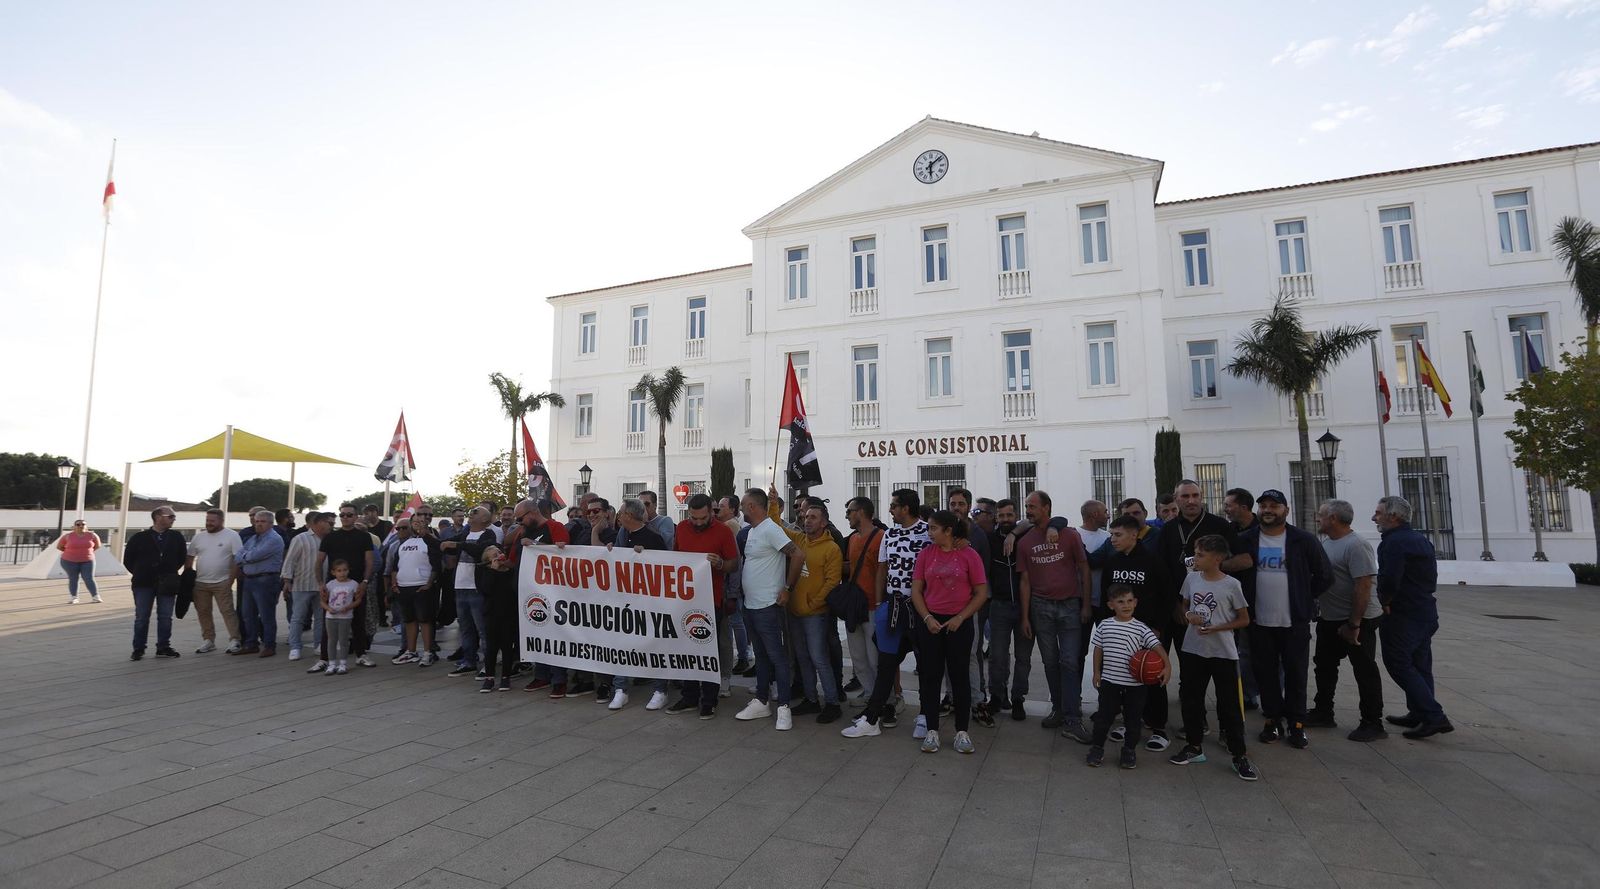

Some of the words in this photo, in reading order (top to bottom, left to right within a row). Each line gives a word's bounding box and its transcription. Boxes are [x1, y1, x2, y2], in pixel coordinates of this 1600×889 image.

[858, 440, 898, 457] CASA
[905, 434, 1029, 456] CONSISTORIAL
[1031, 543, 1060, 553] TRUST
[1031, 552, 1065, 564] PROCESS
[535, 554, 610, 591] GRUPO
[615, 561, 694, 600] NAVEC
[1113, 570, 1145, 581] BOSS
[532, 610, 545, 619] CGT
[554, 600, 647, 637] SOLUCIÓN
[651, 611, 678, 639] YA
[692, 628, 707, 636] CGT
[526, 636, 542, 653] NO
[544, 639, 551, 654] A
[553, 640, 567, 657] LA
[569, 642, 648, 668] DESTRUCCIÓN
[651, 652, 667, 669] DE
[670, 653, 719, 673] EMPLEO
